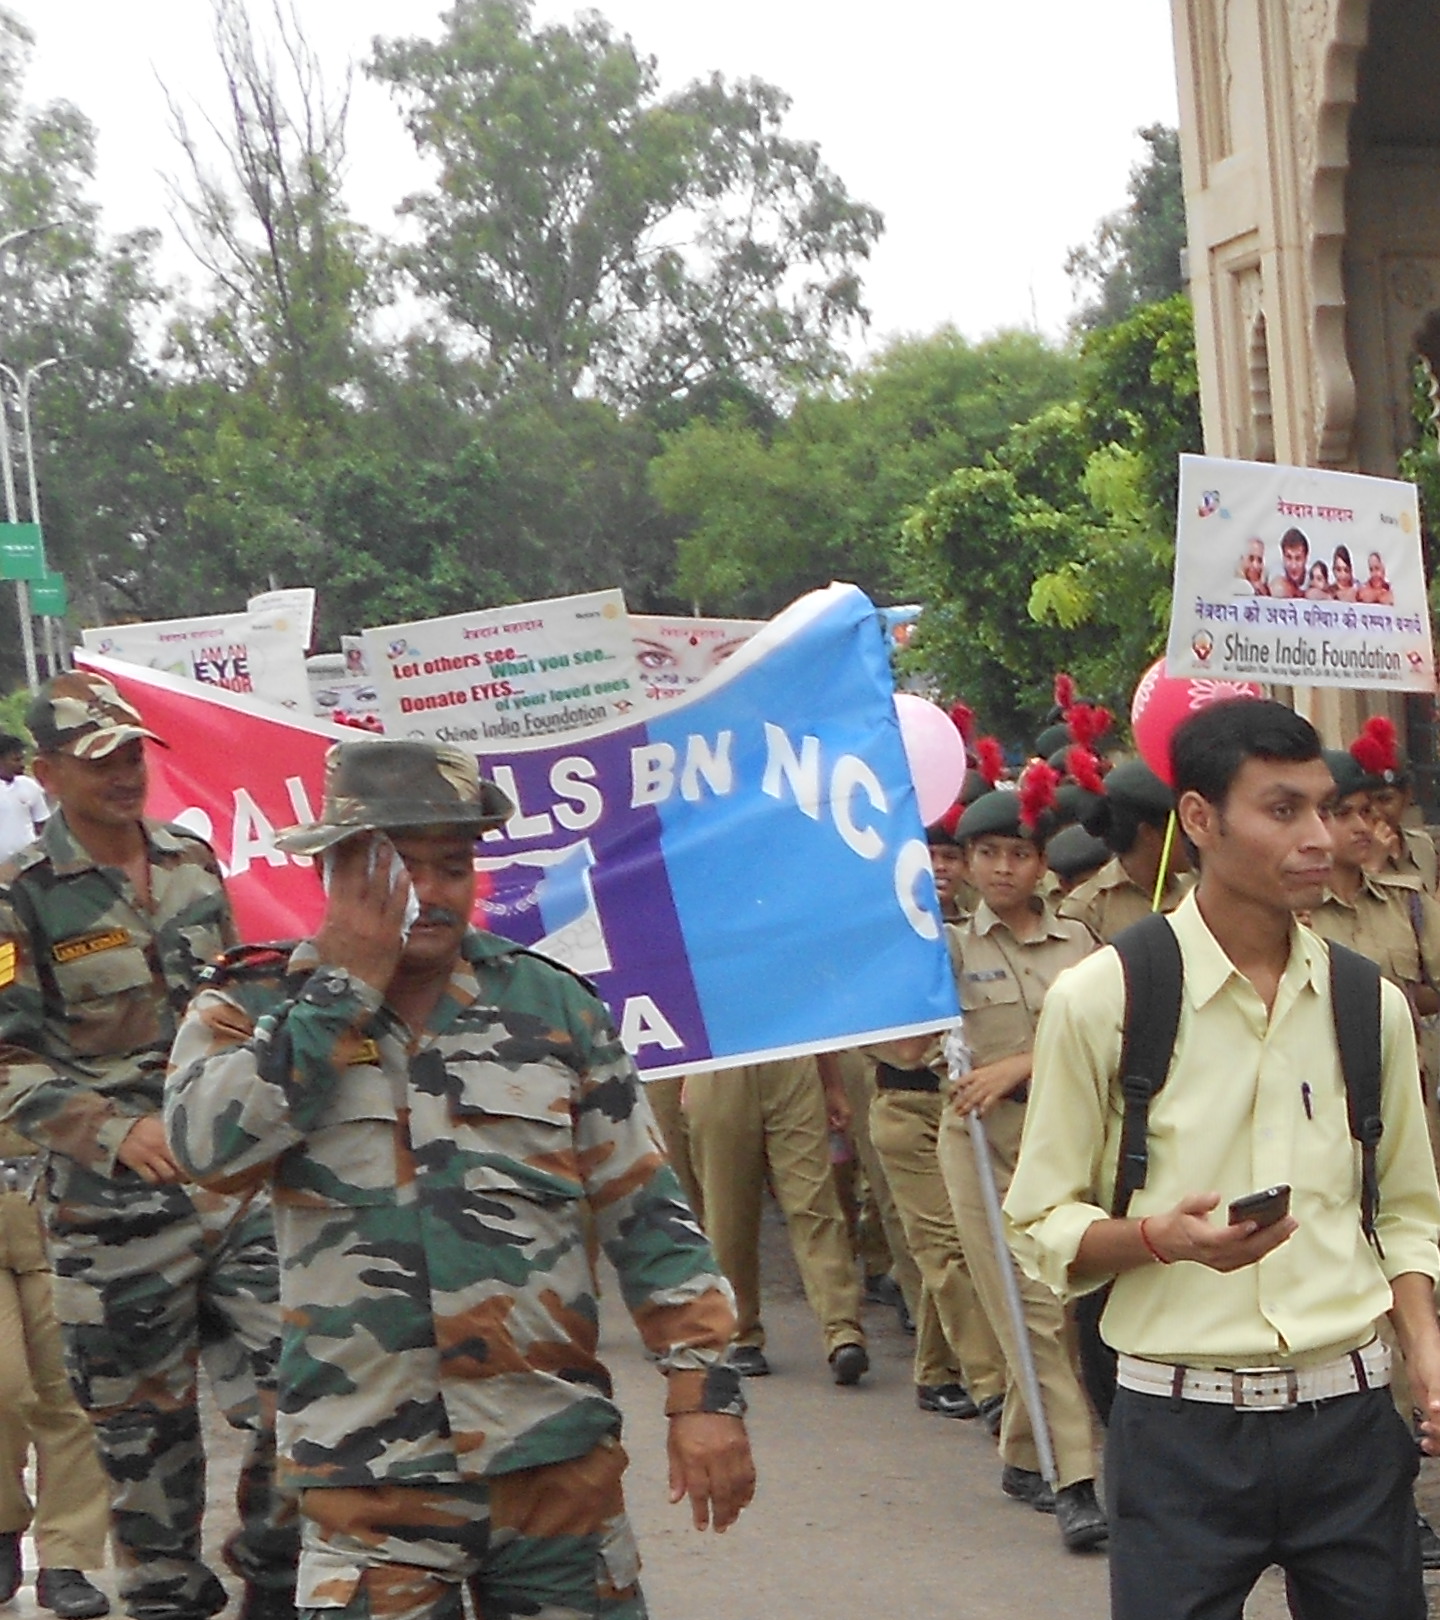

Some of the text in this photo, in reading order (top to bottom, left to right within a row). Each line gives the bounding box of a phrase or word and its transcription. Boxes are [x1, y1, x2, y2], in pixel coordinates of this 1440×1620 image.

[1195, 597, 1238, 623] नेत्रदान
[1244, 601, 1260, 623] को
[1266, 603, 1298, 626] अपने
[201, 646, 221, 661] AM
[229, 644, 248, 660] AN
[1224, 632, 1400, 671] Shine India Foundation
[194, 657, 250, 681] EYE
[393, 663, 421, 681] Let
[423, 653, 482, 675] others
[489, 658, 537, 679] What
[539, 654, 570, 674] you
[400, 689, 467, 714] Donate
[495, 698, 510, 712] of
[512, 692, 546, 710] your
[549, 683, 590, 703] loved
[593, 678, 630, 694] ones
[435, 724, 478, 743] Shine
[482, 718, 520, 739] India
[524, 704, 607, 733] Foundation
[482, 756, 604, 841] LS
[632, 730, 732, 809] BN
[762, 721, 940, 941] NCC
[603, 995, 685, 1055] A
